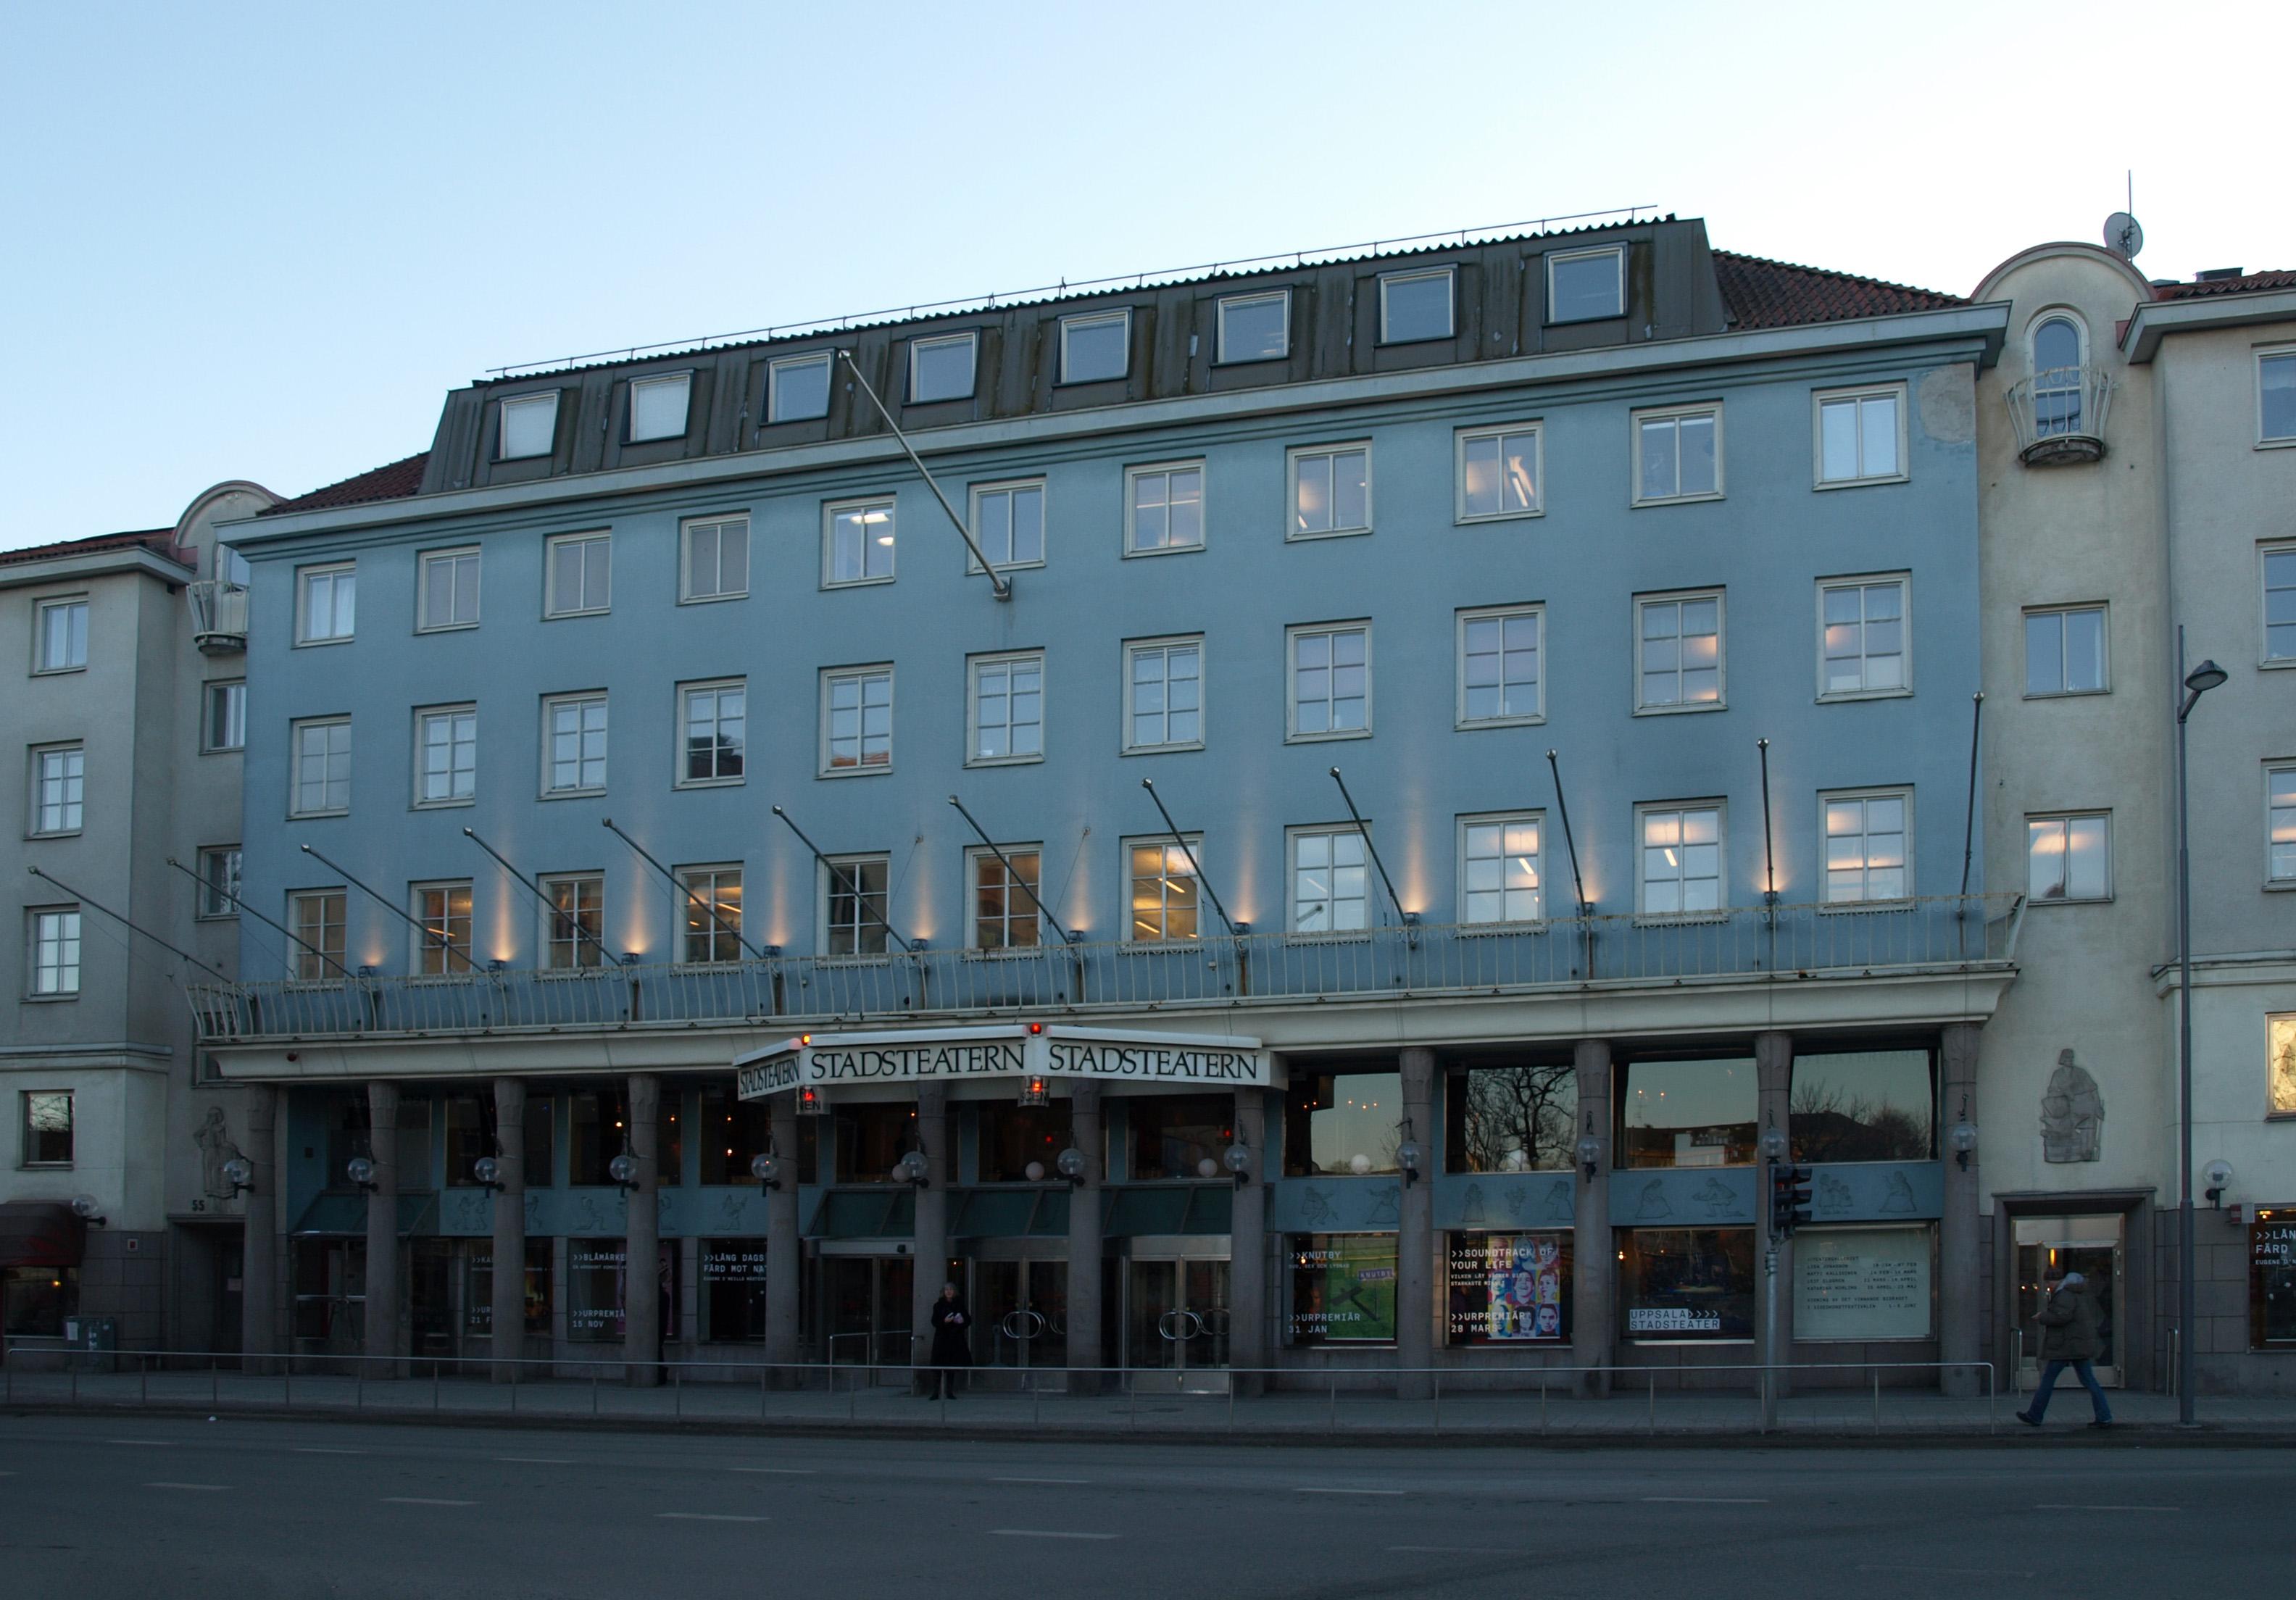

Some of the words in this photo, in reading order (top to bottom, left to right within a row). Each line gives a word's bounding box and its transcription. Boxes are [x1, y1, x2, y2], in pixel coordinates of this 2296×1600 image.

[812, 1044, 1026, 1078] STADSTEATERN
[1049, 1044, 1258, 1079] STADSTEATERN
[740, 1057, 800, 1095] STADSTEATERN
[192, 1199, 204, 1211] 55
[2255, 1243, 2289, 1254] FÄRD
[1360, 1270, 1391, 1279] KNUTBY
[1631, 1320, 1719, 1329] STADSTEATER
